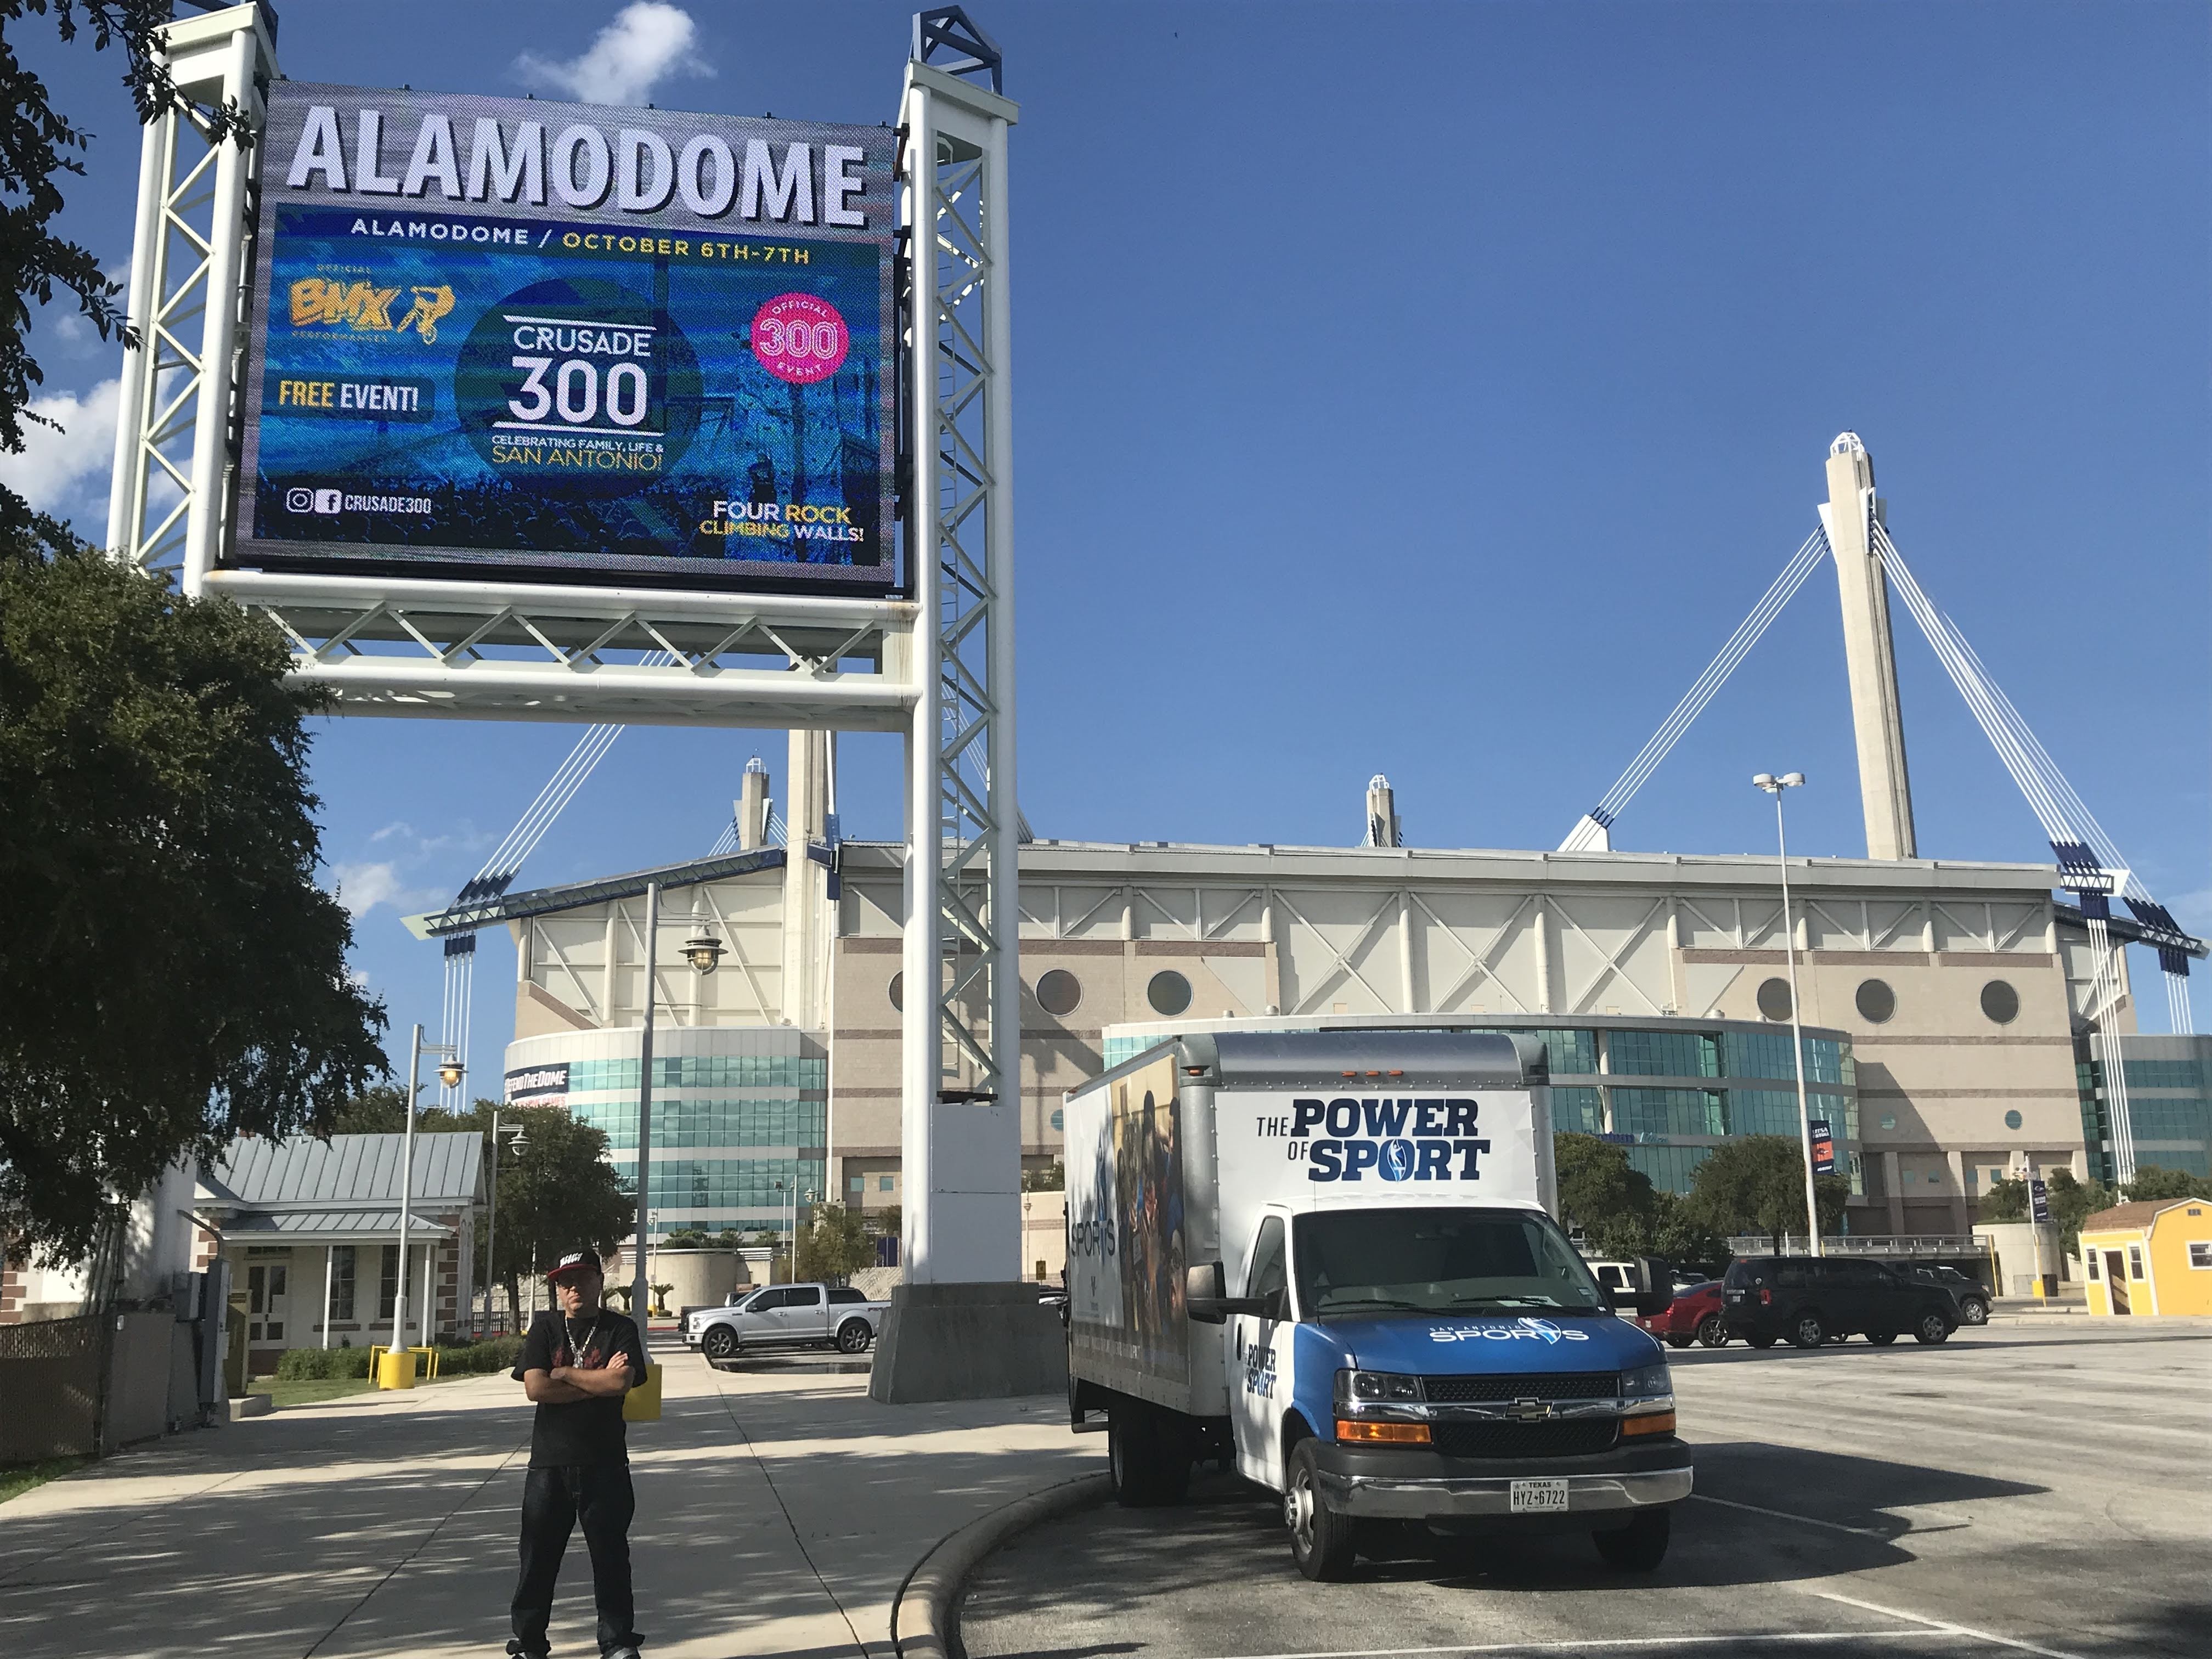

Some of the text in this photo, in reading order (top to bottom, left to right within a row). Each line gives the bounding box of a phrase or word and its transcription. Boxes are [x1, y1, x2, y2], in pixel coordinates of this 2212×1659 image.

[286, 106, 867, 229] ALAMODOME
[351, 218, 528, 245] ALAMODOME
[562, 232, 689, 256] OCTOBER
[701, 242, 809, 264] 6TH-7TH
[289, 276, 401, 331] BMX
[772, 300, 827, 318] OFFICIAL
[514, 325, 651, 357] CRUSADE
[759, 318, 838, 360] 300
[776, 360, 822, 376] EVENT
[279, 380, 419, 412] FREE EVENT!
[508, 356, 647, 426] 300
[492, 435, 664, 453] CELEBRATING FAMILY, LIFE &
[492, 445, 663, 471] SAN ANTONIO!
[344, 494, 432, 514] CRUSADE300
[713, 500, 851, 524] FOUR ROCK
[698, 520, 864, 542] CLIMBING WALLS!
[1256, 1098, 1479, 1137] THE POWER
[1288, 1139, 1491, 1182] OF SPORT
[1071, 1218, 1115, 1257] SPORTS
[1429, 1329, 1589, 1344] SPORTS
[1248, 1344, 1276, 1373] POWER
[1246, 1368, 1277, 1400] SPORT
